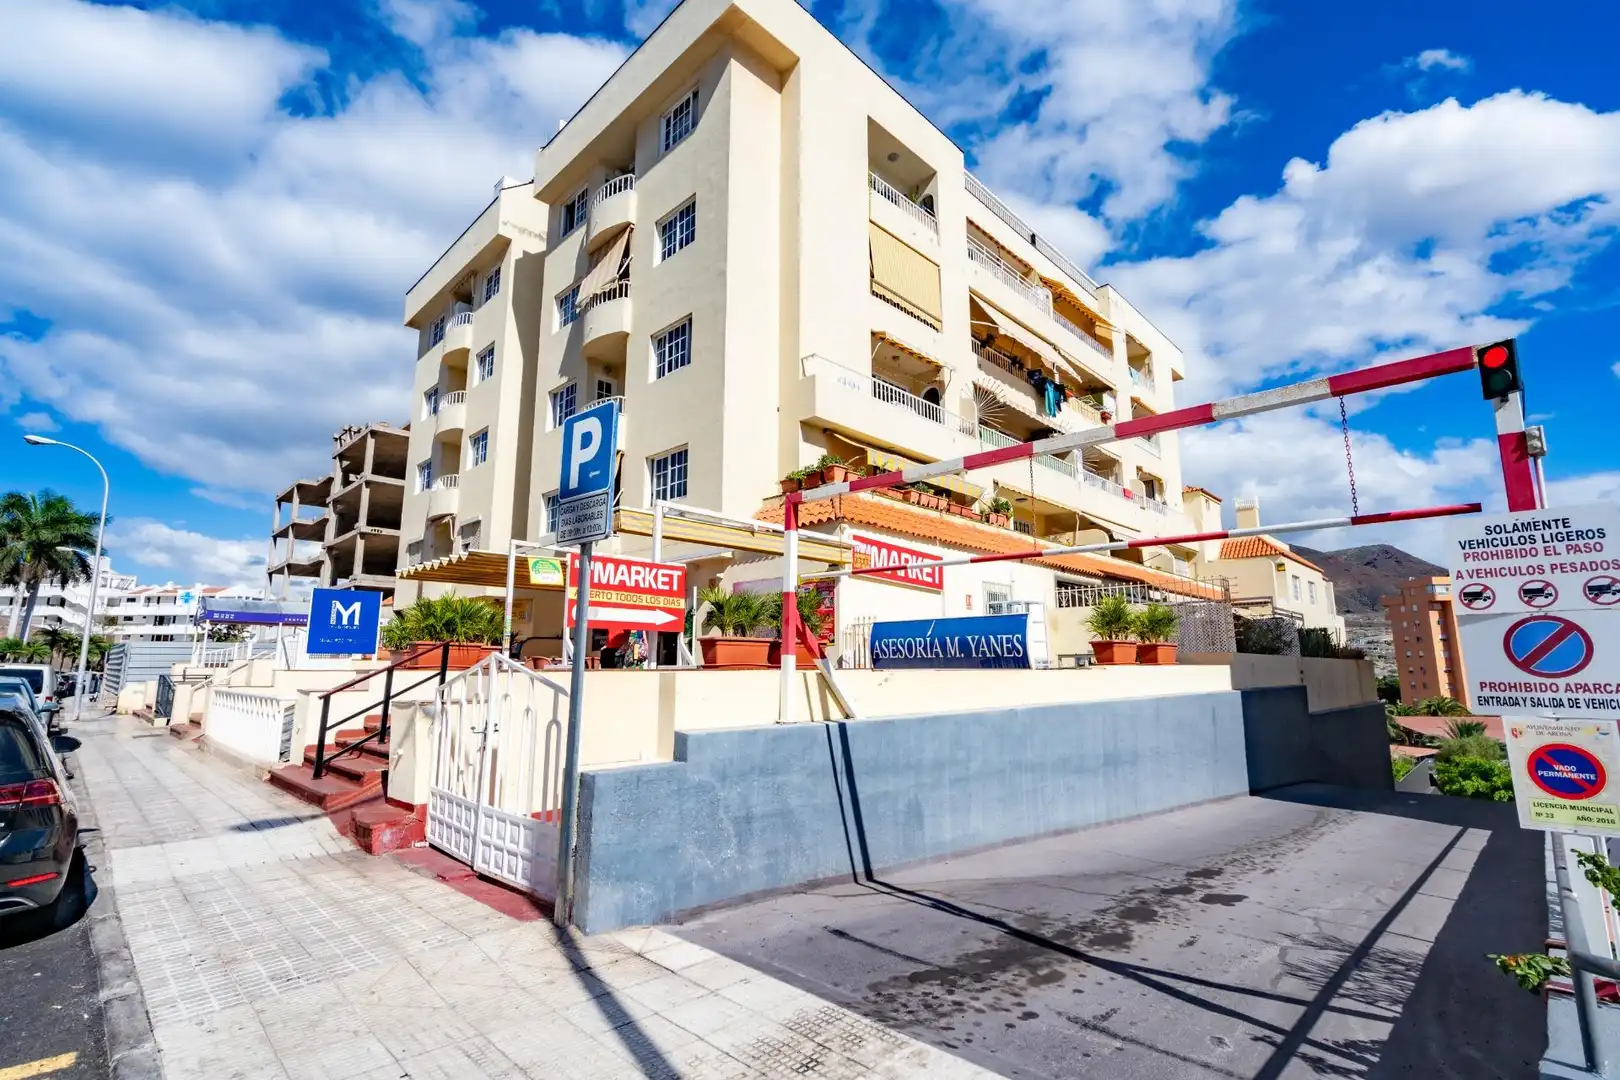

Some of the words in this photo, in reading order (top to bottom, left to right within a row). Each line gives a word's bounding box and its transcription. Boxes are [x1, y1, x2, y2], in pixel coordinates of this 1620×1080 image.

[568, 416, 602, 490] P
[580, 498, 606, 511] DESCARGA
[572, 510, 603, 524] LABORABLES
[1484, 517, 1571, 535] SOLAMENTE
[1458, 534, 1537, 551] VEHICULOS
[1541, 527, 1606, 544] LIGEROS
[1463, 547, 1539, 562] PROHIBIDO
[1543, 547, 1562, 557] EL
[1565, 541, 1604, 555] PASO
[871, 546, 941, 584] MARKET
[1455, 570, 1465, 580] A
[1466, 564, 1546, 580] VEHICULOS
[1550, 558, 1620, 574] PESADOS
[593, 561, 682, 591] MARKET
[615, 592, 643, 603] TODOS
[645, 595, 661, 605] LOS
[663, 597, 681, 607] DIAS
[873, 620, 942, 659] ASESORÍA
[945, 636, 965, 658] M.
[966, 633, 1024, 658] YANES
[1479, 682, 1560, 693] PROHIBIDO
[1477, 696, 1521, 707] ENTRADA
[1520, 696, 1528, 704] Y
[1530, 696, 1566, 708] SALIDA
[1567, 698, 1581, 709] DE
[1538, 770, 1597, 780] PERMANENTE
[1533, 801, 1568, 810] LICENCIA
[1569, 804, 1614, 815] MUNICIPAL
[1576, 815, 1595, 823] AÑO:
